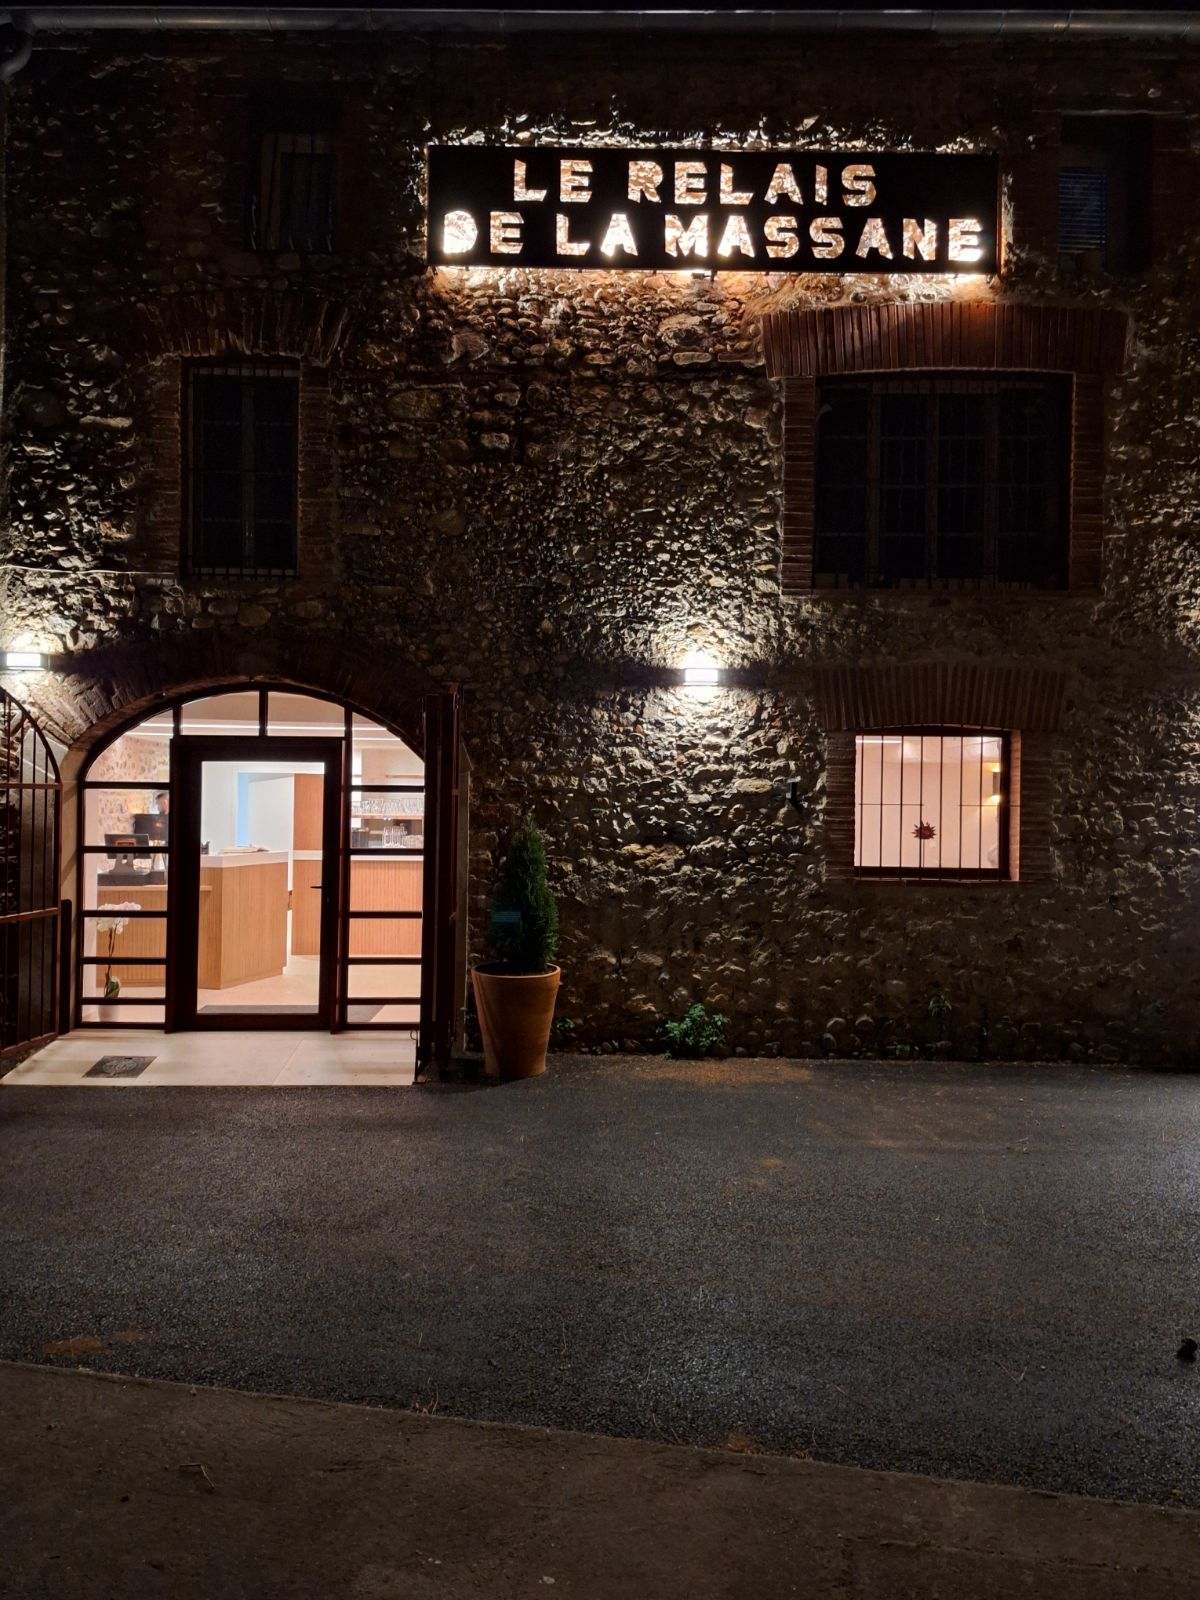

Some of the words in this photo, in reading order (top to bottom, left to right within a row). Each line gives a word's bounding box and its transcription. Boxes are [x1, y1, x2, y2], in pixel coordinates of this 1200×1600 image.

[514, 160, 593, 202] LE
[628, 161, 876, 206] RELAIS
[443, 210, 524, 255] DE
[556, 212, 638, 258] LA
[665, 214, 985, 262] MASSANE
